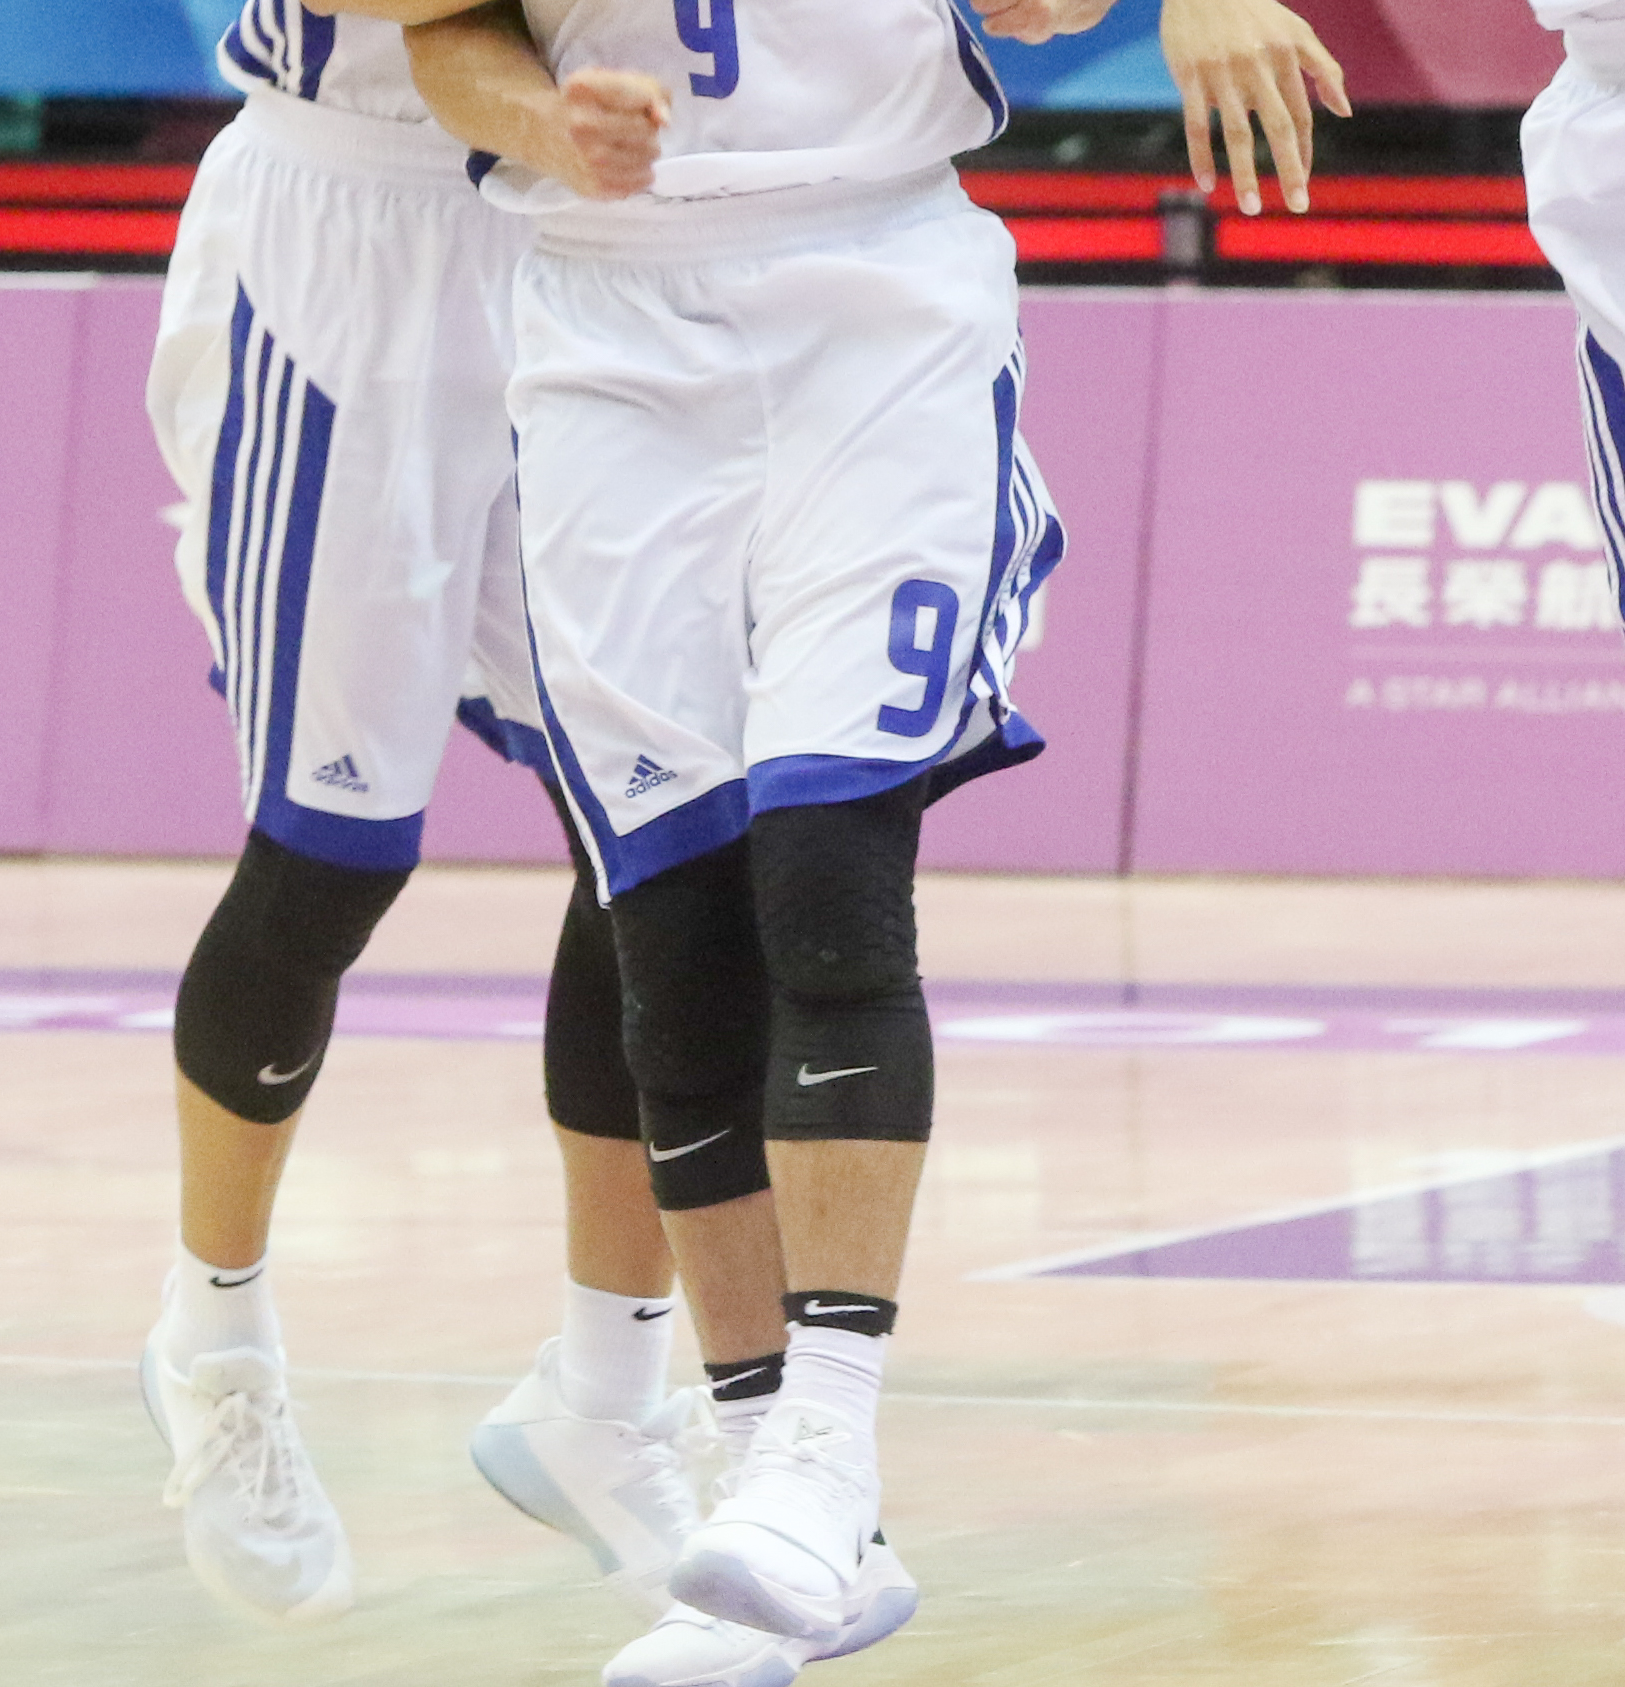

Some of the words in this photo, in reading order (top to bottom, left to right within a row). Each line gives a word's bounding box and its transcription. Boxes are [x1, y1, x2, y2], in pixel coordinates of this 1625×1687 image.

[1353, 480, 1603, 550] EVA
[876, 578, 960, 738] 9
[625, 770, 678, 799] adidas
